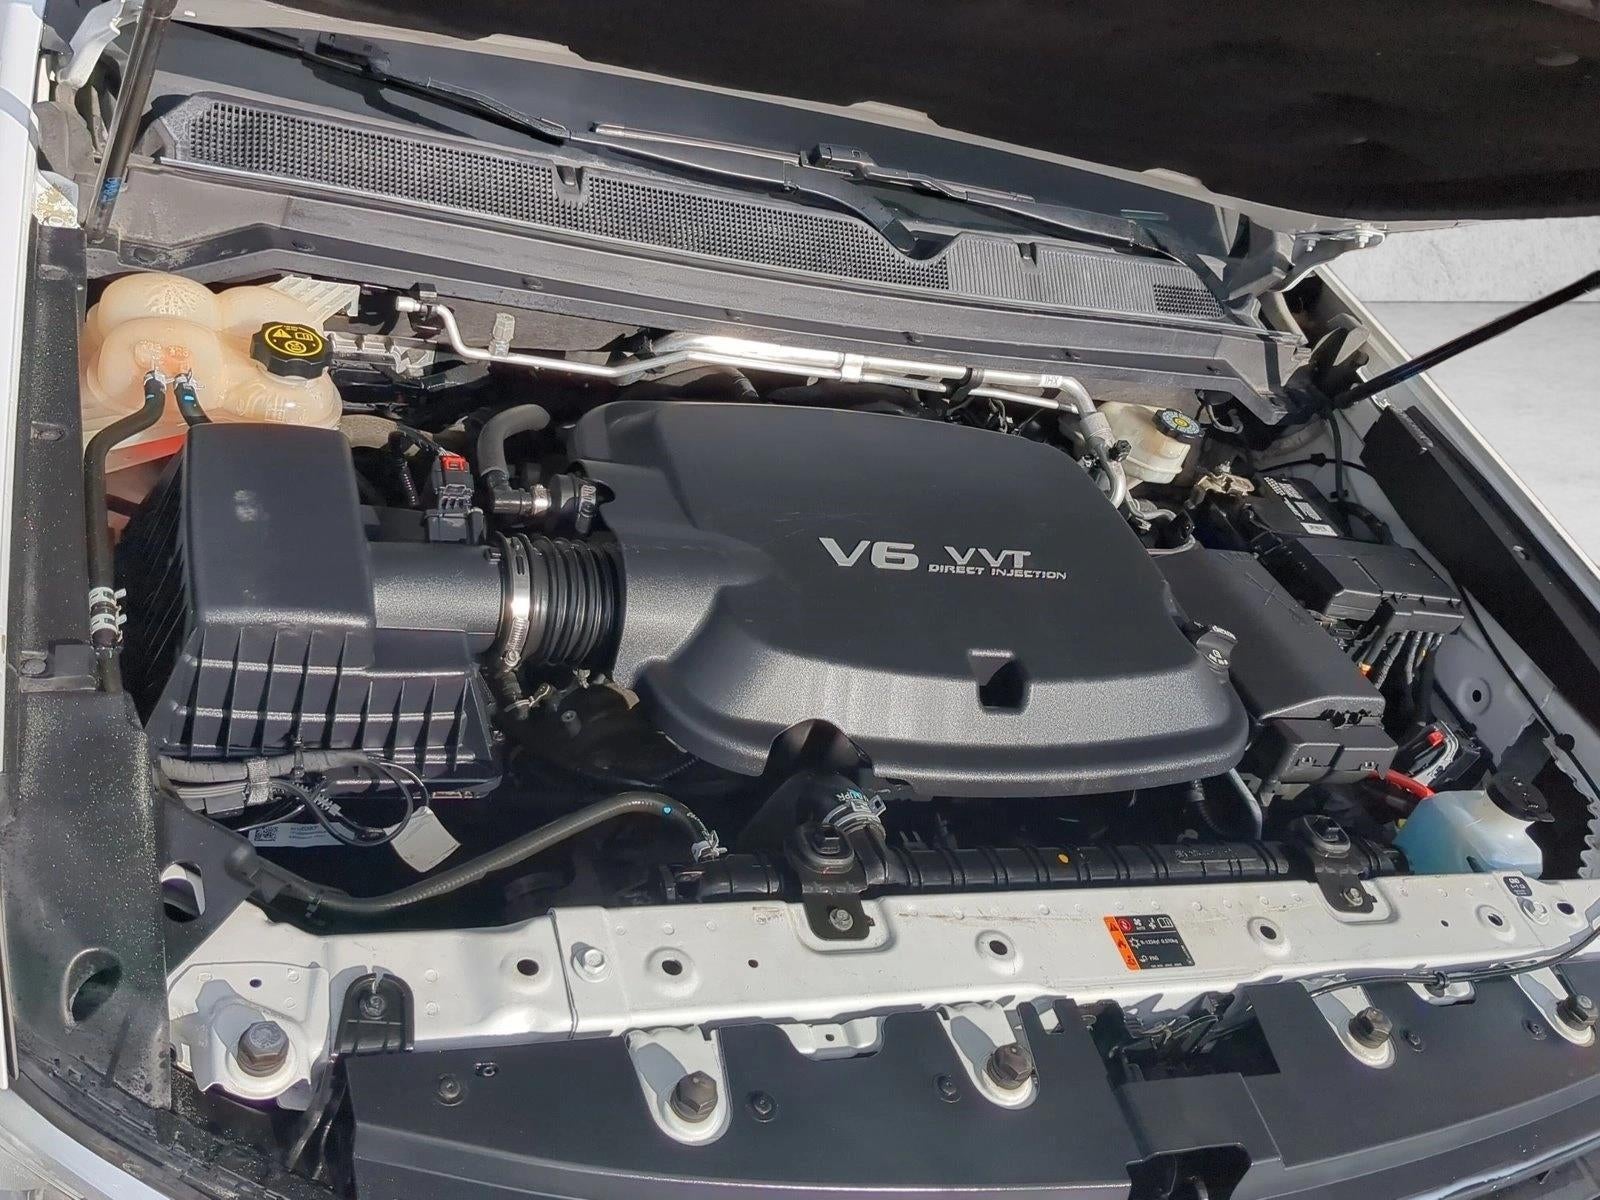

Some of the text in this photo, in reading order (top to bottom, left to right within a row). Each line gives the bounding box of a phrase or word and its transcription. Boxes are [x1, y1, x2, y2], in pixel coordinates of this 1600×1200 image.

[818, 537, 920, 571] V6
[944, 545, 1032, 569] VVT
[928, 563, 1068, 580] DIRECT INJECTION
